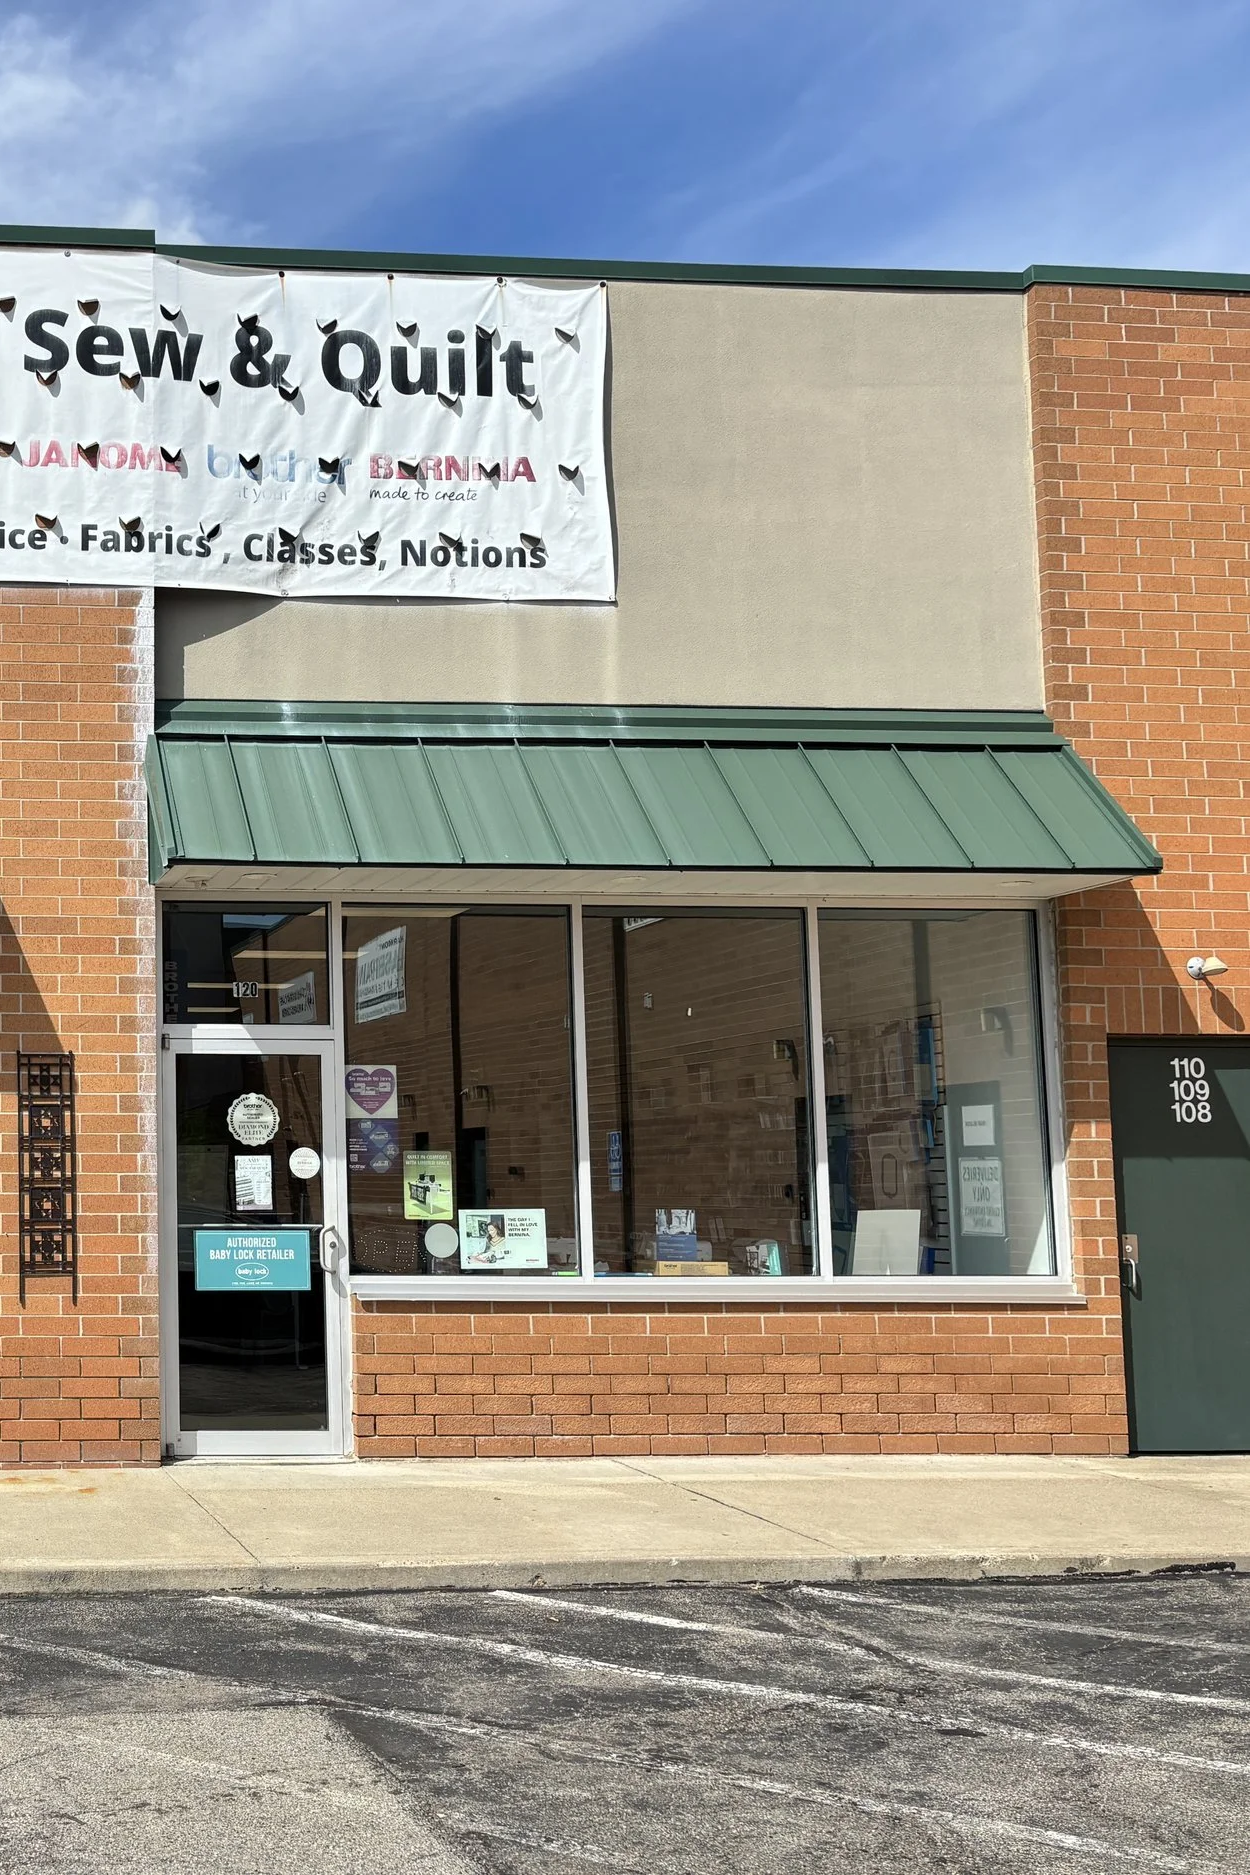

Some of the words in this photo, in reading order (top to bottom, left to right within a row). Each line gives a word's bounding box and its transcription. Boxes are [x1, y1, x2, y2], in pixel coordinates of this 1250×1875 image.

[24, 308, 204, 382] Sew
[229, 324, 294, 389] &
[321, 328, 535, 408] Quilt
[369, 487, 410, 501] made
[415, 487, 429, 501] to
[435, 487, 478, 501] create
[243, 532, 387, 571] Classes,
[401, 538, 547, 569] Notions
[234, 983, 258, 997] 120
[1170, 1057, 1205, 1079] 110
[1169, 1080, 1210, 1101] 109
[1171, 1101, 1212, 1123] 108
[227, 1237, 277, 1247] AUTHORIZED
[210, 1249, 231, 1259] BABY
[234, 1249, 254, 1259] LOCK
[257, 1249, 295, 1259] RETAILER
